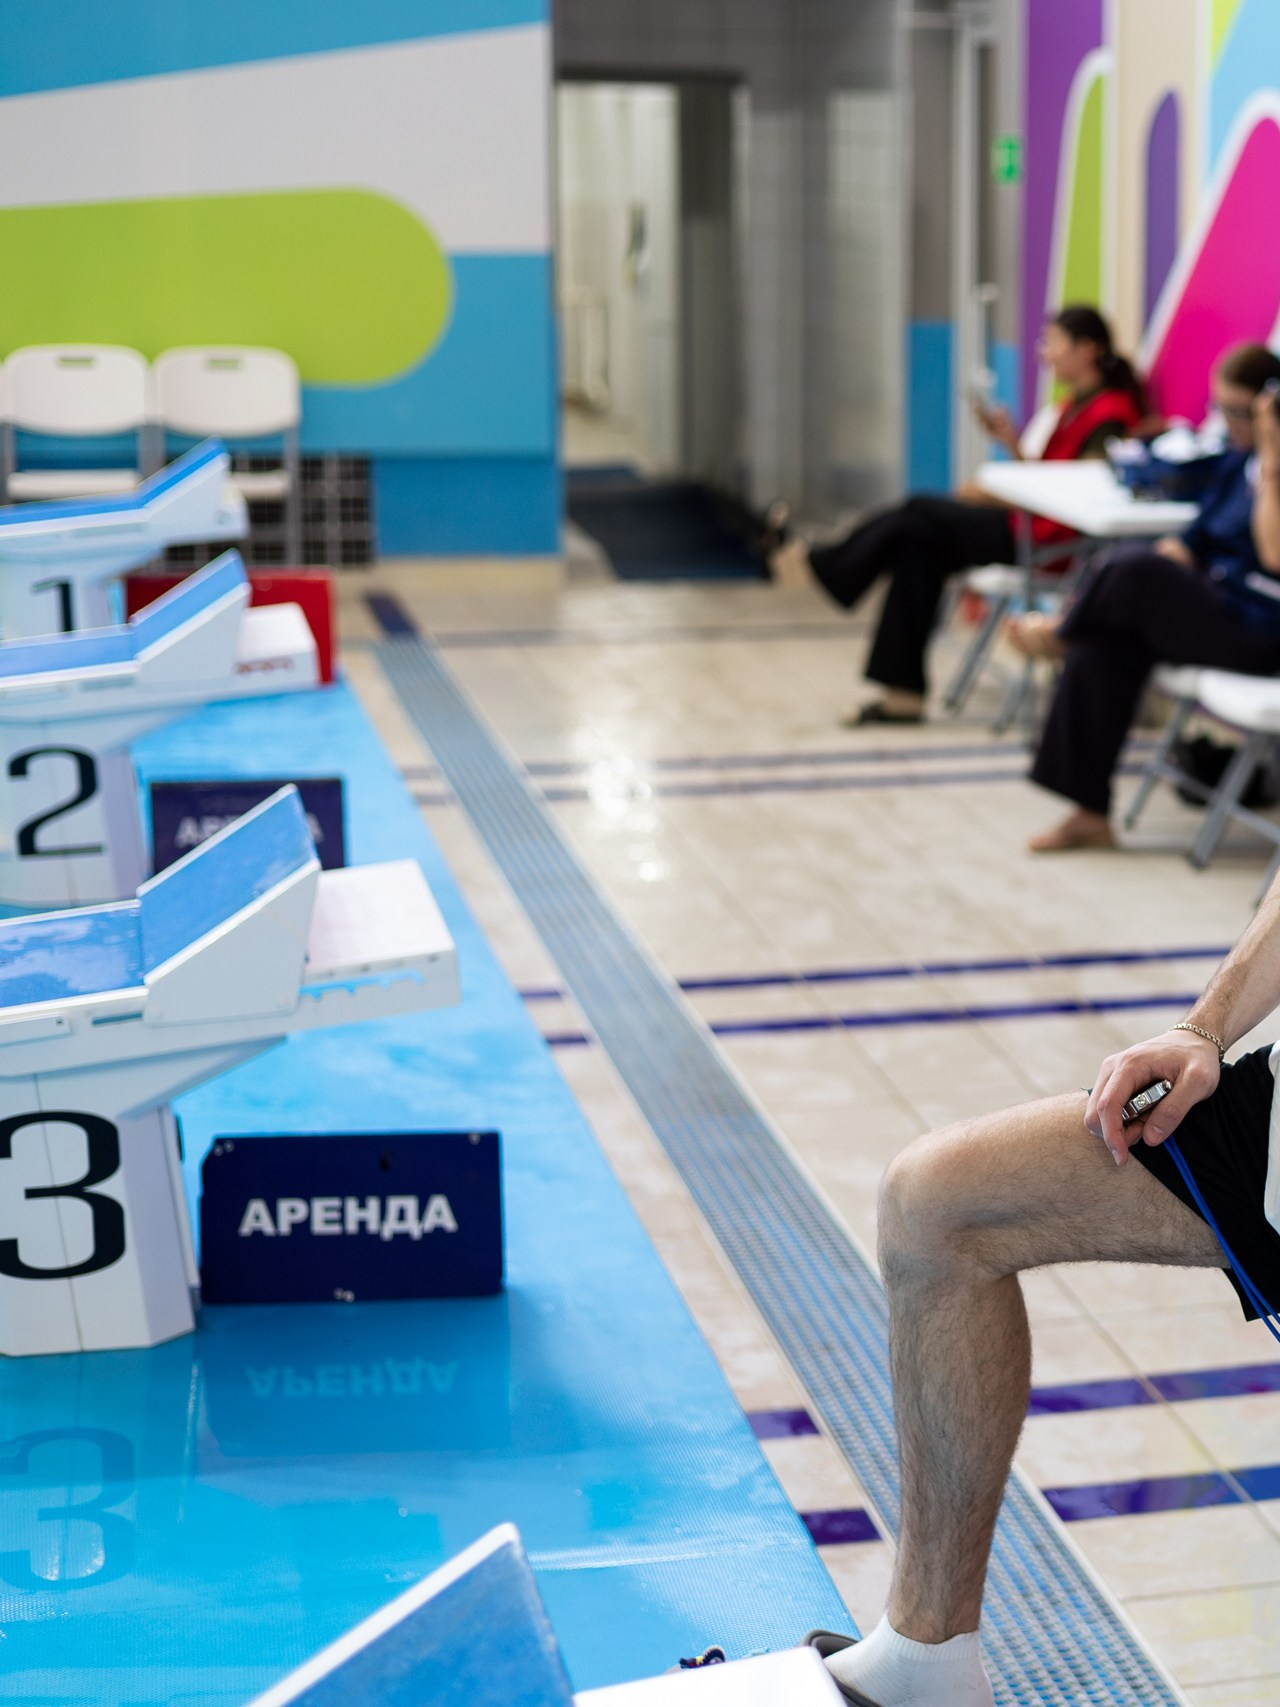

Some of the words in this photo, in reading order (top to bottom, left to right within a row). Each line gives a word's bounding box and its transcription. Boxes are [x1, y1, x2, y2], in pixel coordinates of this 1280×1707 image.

[31, 578, 76, 633] 1
[8, 746, 105, 857] 2
[0, 1111, 125, 1281] 3
[239, 1195, 458, 1240] АРЕНДА
